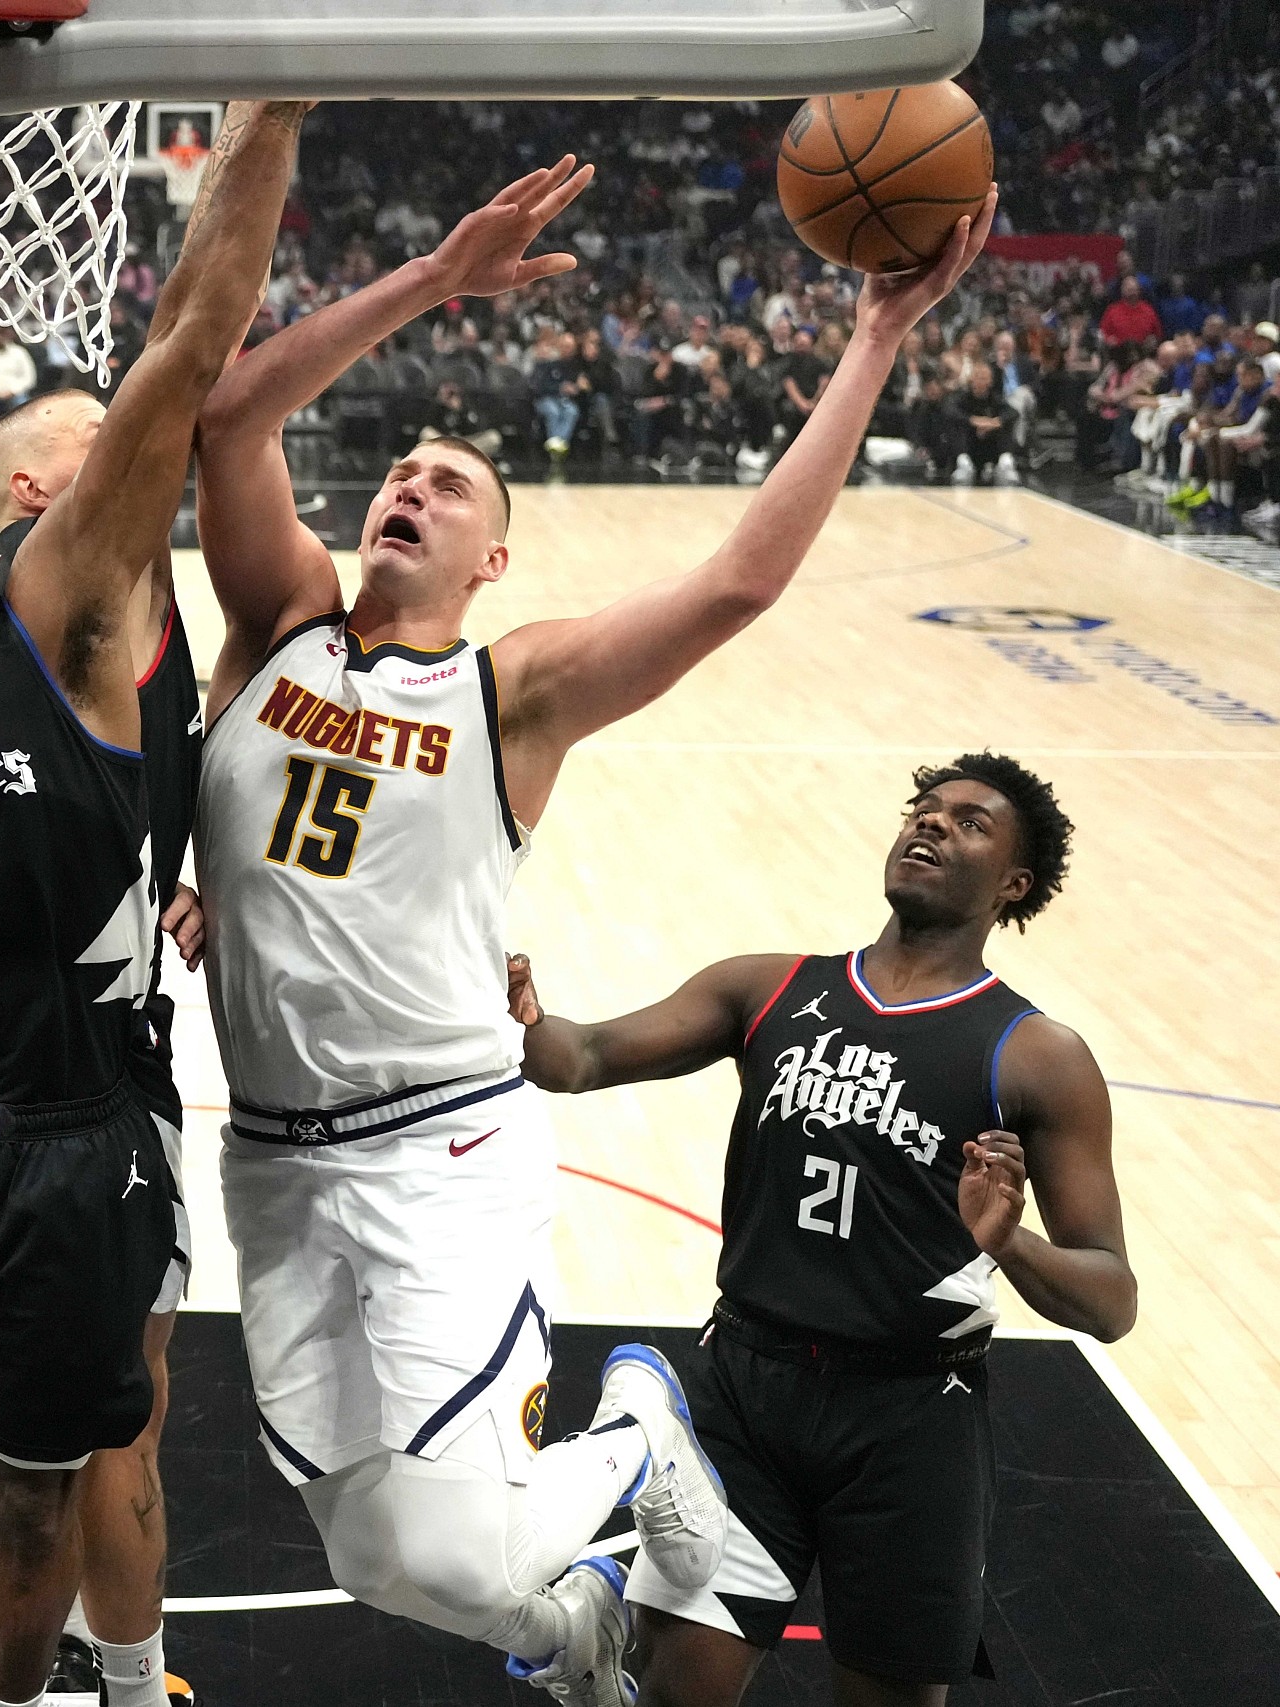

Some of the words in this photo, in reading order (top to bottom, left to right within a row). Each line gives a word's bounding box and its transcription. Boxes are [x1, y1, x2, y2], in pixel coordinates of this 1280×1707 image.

[400, 666, 458, 686] ibotta
[256, 675, 453, 777] NUGGETS
[263, 754, 377, 880] 15
[800, 1027, 898, 1091] Los
[757, 1045, 946, 1167] Angeles
[798, 1154, 859, 1239] 21
